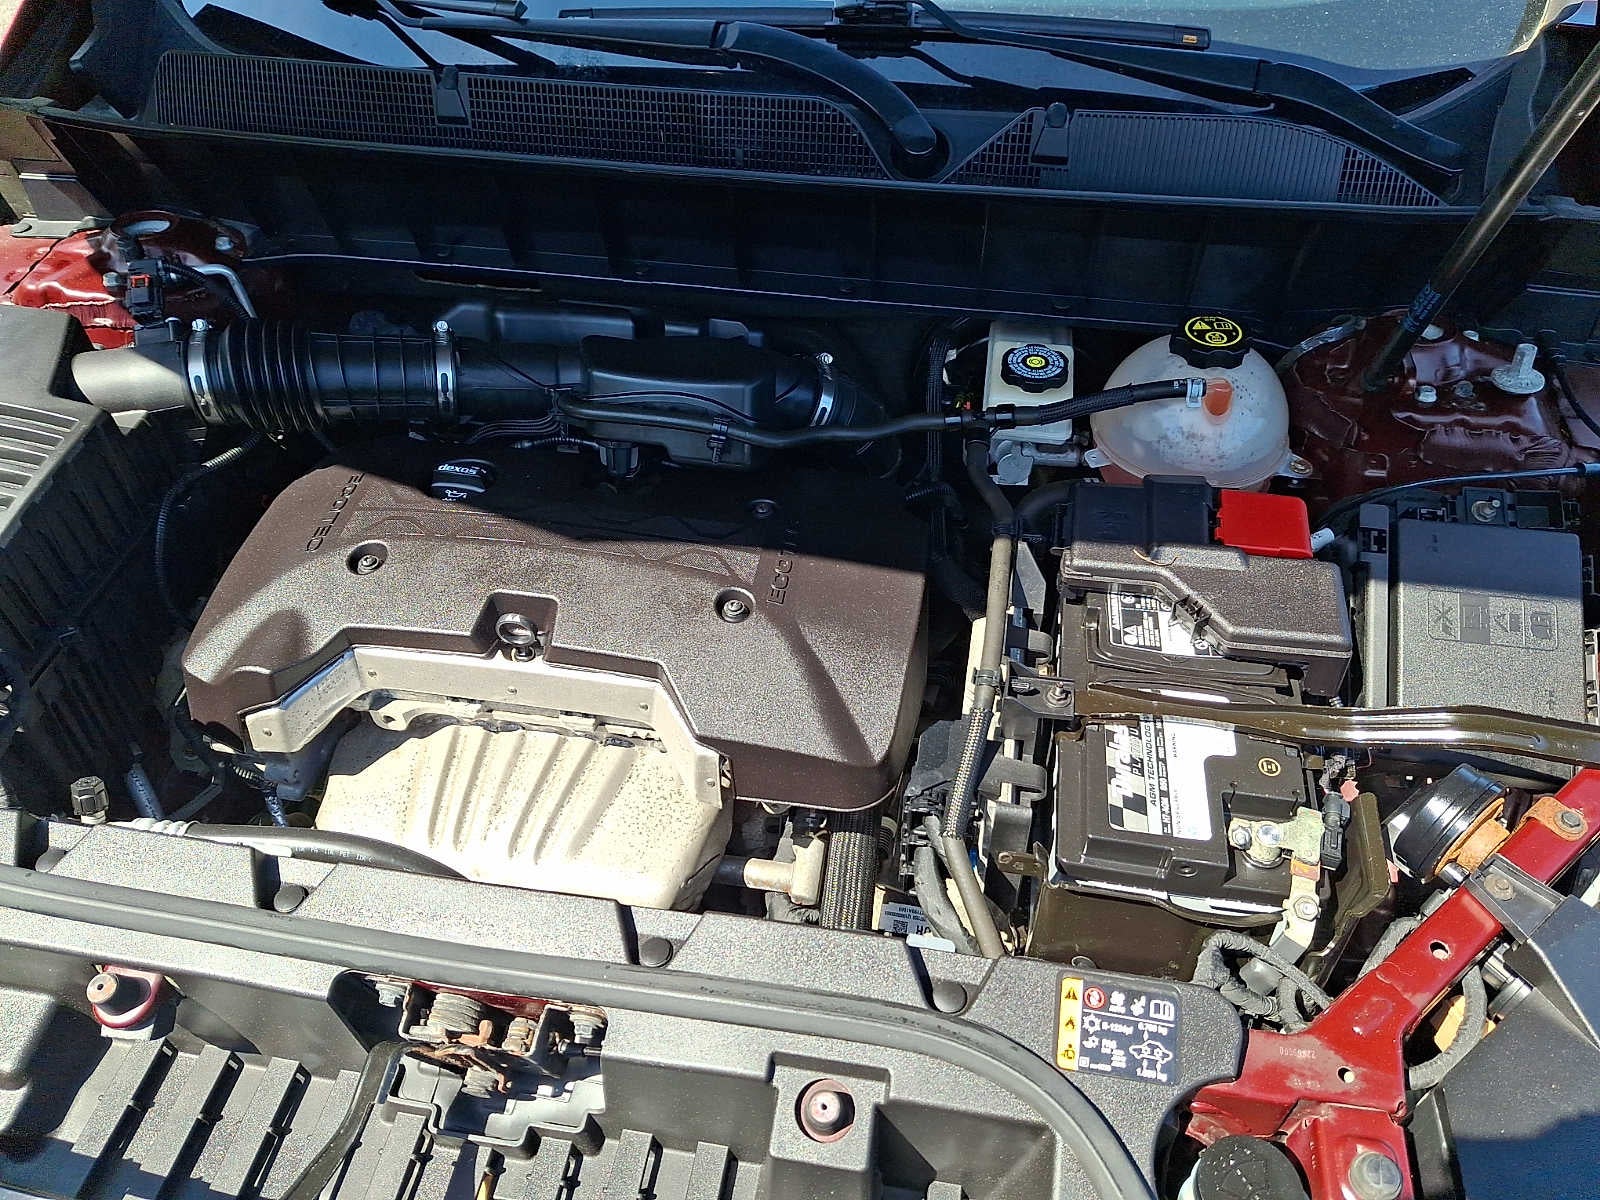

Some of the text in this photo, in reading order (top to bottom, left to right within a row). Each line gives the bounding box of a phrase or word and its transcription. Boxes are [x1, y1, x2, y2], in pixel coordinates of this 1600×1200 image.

[437, 463, 477, 475] dexos
[1108, 723, 1135, 799] Duralas
[1147, 783, 1157, 807] AGM
